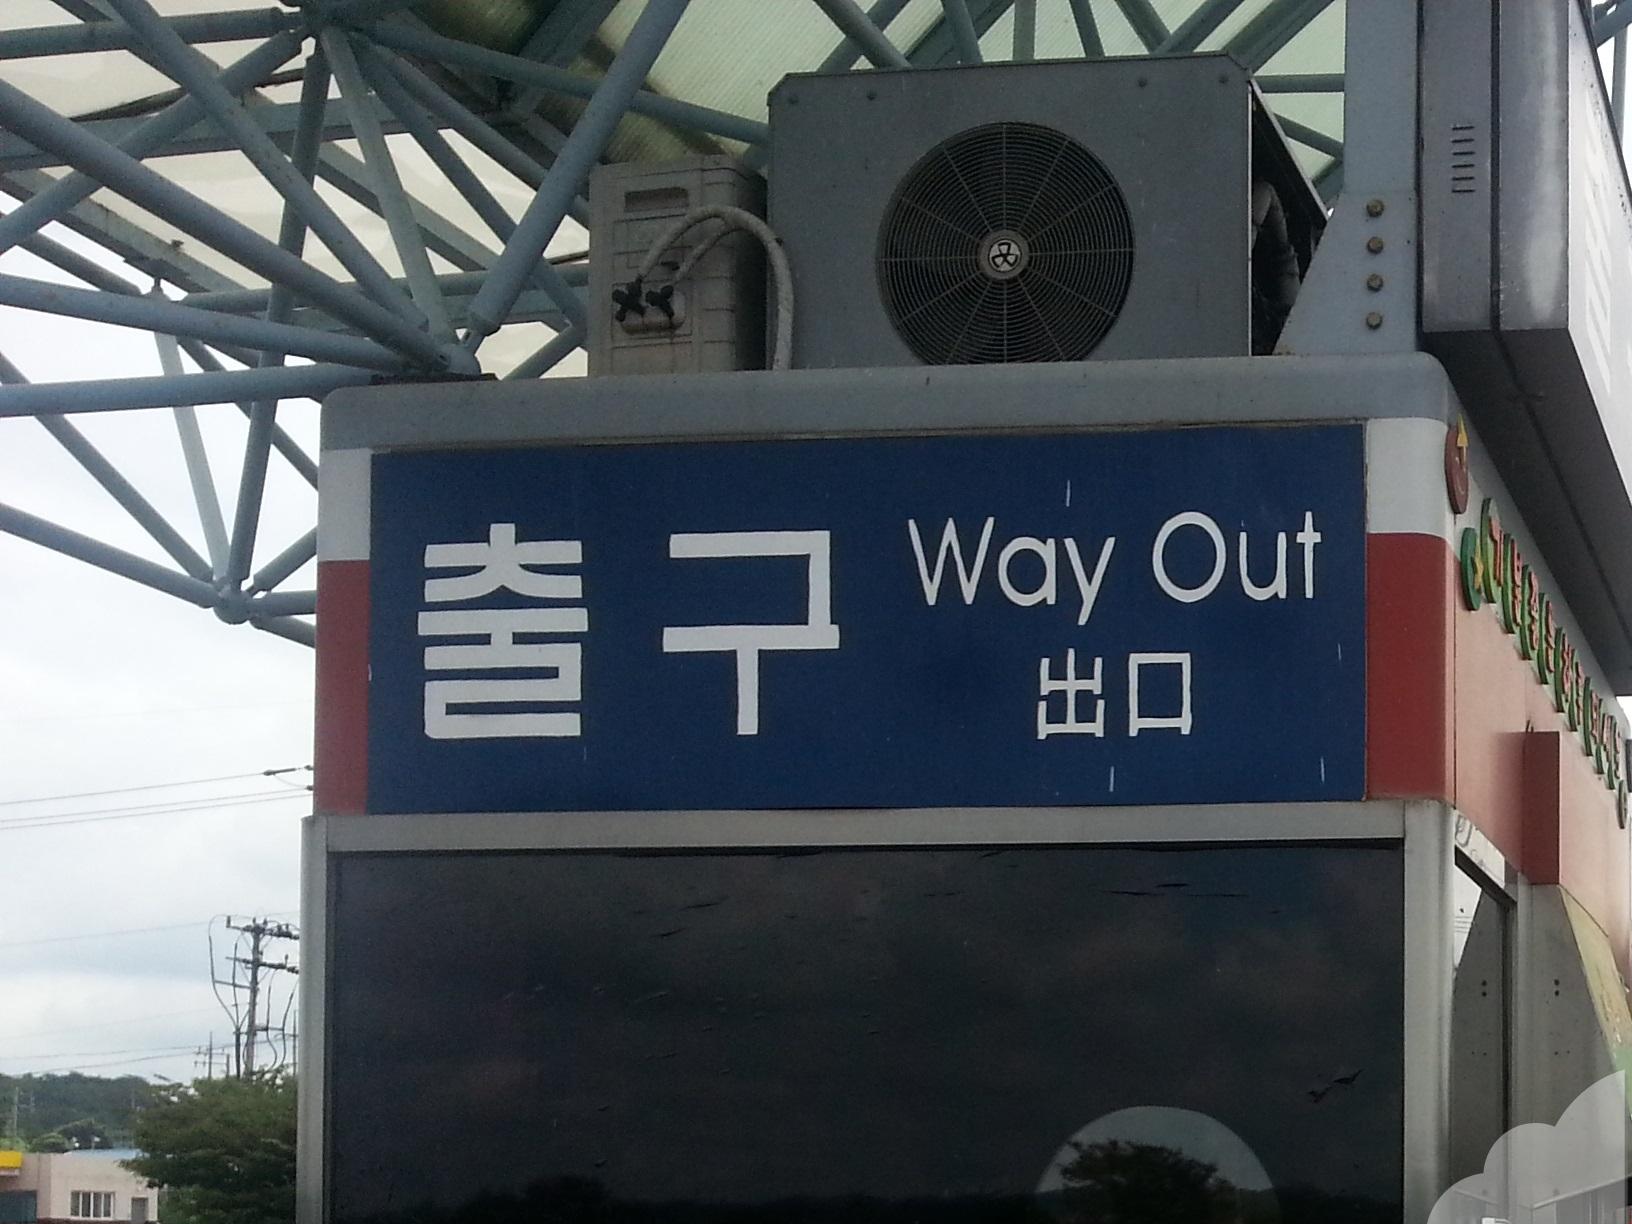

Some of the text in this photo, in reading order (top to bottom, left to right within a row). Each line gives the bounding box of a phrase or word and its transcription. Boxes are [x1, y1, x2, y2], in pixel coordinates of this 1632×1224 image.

[907, 510, 1321, 625] Way Out
[1036, 647, 1193, 740] 出口
